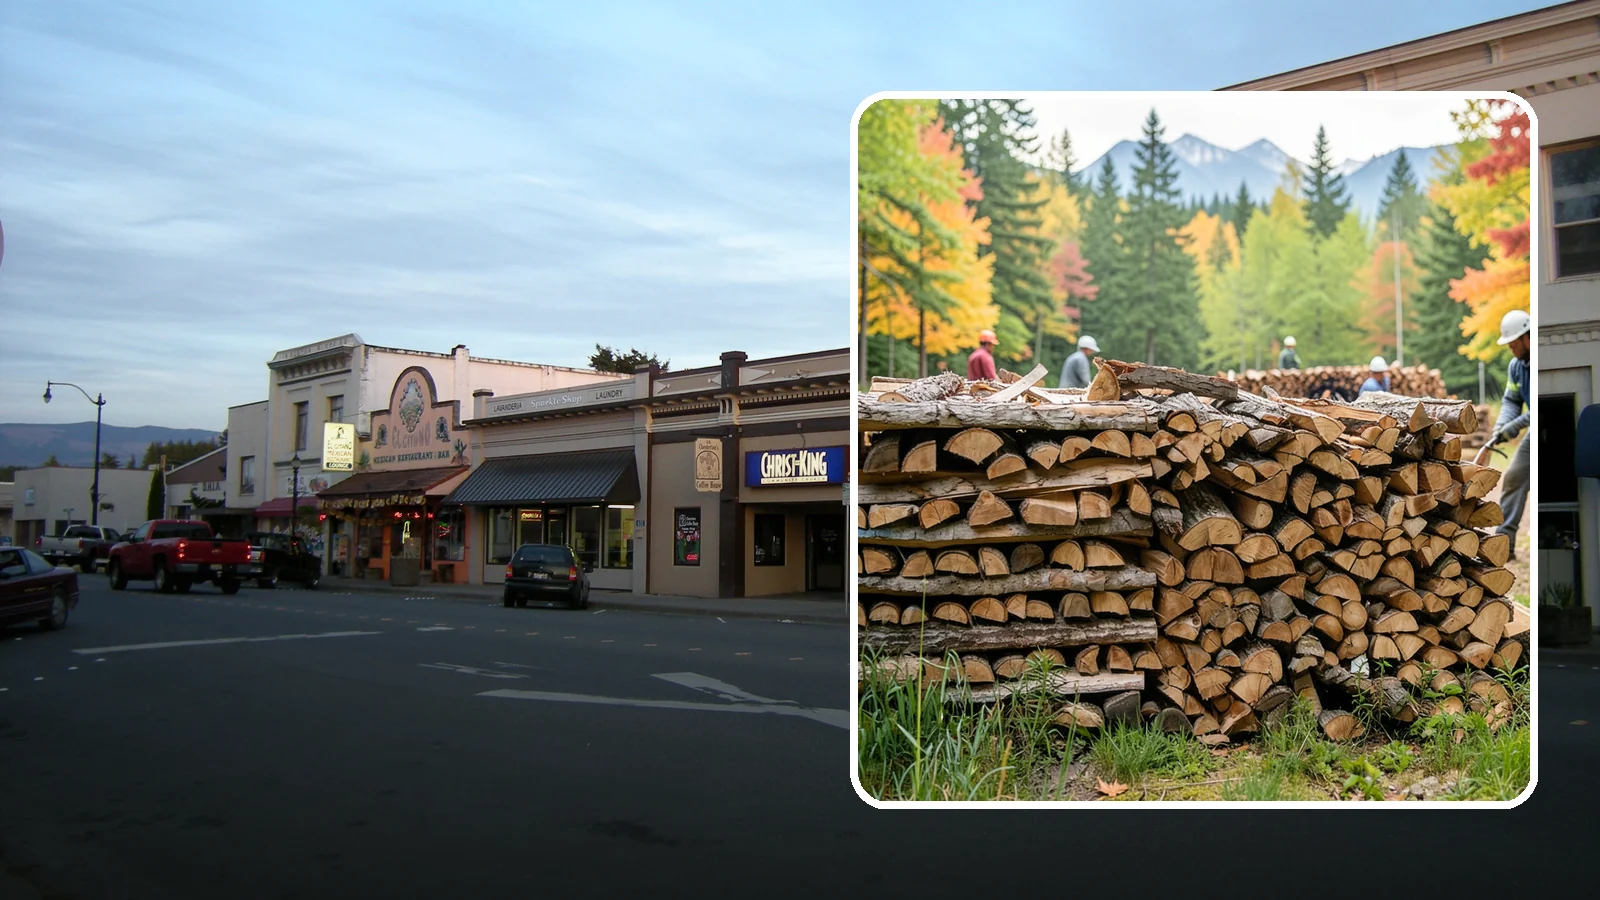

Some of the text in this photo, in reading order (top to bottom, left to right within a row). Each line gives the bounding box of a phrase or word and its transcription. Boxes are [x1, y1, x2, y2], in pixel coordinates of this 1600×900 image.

[493, 389, 623, 412] LAVANDERIA Sparkle Shop LAUNDRY
[392, 425, 401, 449] EL
[373, 455, 396, 464] MEXICAN
[397, 451, 433, 462] RESTAURANT
[438, 450, 450, 459] BAR
[761, 450, 827, 477] CHRIST KING
